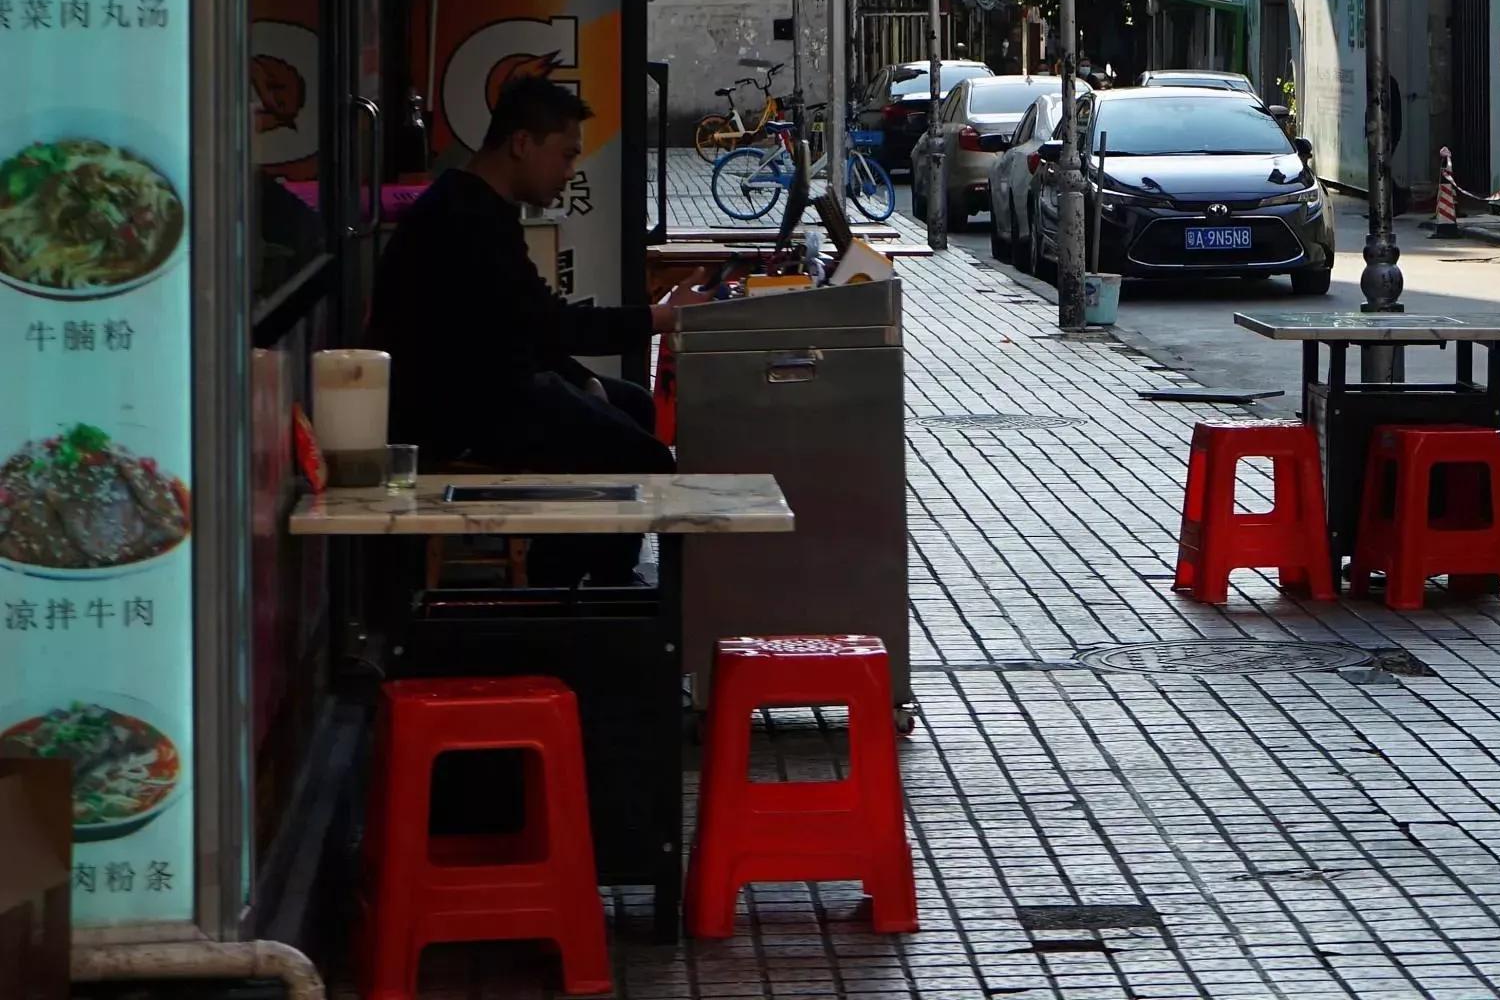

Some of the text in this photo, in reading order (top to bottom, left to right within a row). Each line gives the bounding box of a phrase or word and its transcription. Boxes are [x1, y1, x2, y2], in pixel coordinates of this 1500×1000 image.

[25, 320, 135, 352] 牛腩粉
[5, 597, 155, 631] 凉拌牛肉
